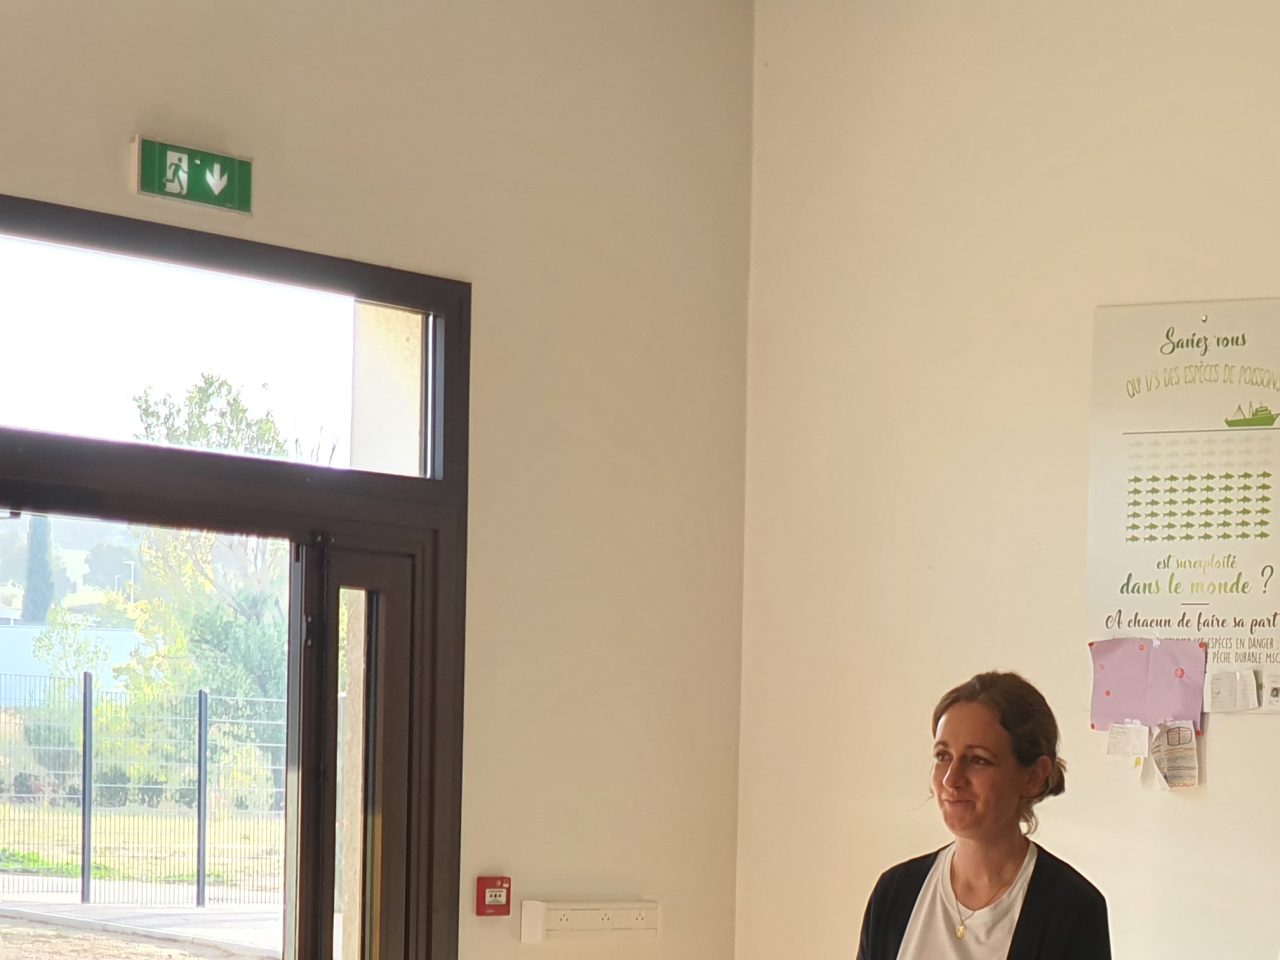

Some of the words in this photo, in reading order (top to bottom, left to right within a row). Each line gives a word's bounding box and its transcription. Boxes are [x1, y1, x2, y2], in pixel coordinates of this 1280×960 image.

[1163, 365, 1181, 388] DES
[1223, 363, 1236, 384] DE
[1156, 554, 1174, 570] est
[1175, 553, 1238, 575] surexploité
[1120, 572, 1162, 595] dans
[1168, 572, 1183, 595] le
[1190, 571, 1252, 595] monde
[1260, 564, 1275, 594] ?
[1105, 608, 1123, 630] A
[1127, 612, 1173, 629] chacun
[1177, 612, 1192, 629] de
[1196, 612, 1228, 633] faire
[1232, 616, 1245, 629] sa
[1235, 637, 1245, 650] EN
[1247, 637, 1274, 650] DANGER
[1234, 651, 1263, 664] DURABLE
